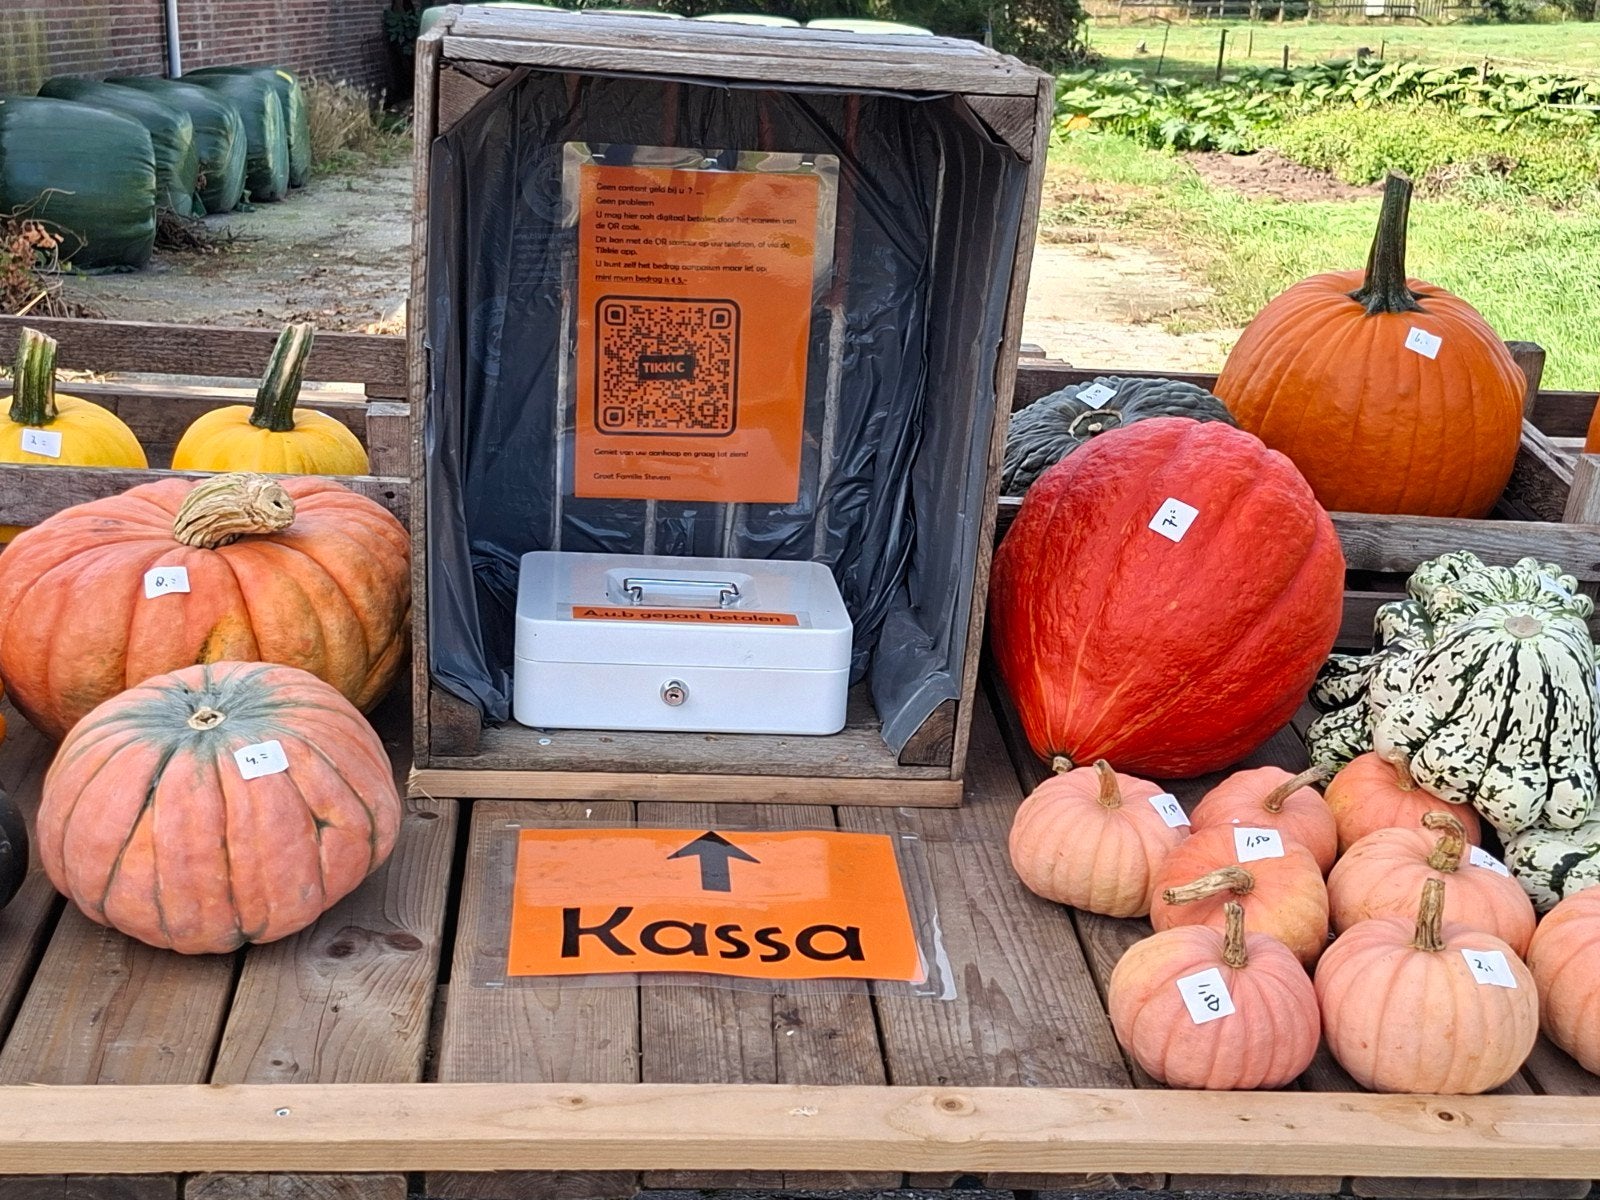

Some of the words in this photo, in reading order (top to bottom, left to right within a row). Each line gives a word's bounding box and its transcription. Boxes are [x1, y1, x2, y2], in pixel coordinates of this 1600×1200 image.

[596, 183, 616, 191] Geen
[667, 186, 677, 195] bij
[596, 197, 616, 205] Geen
[618, 197, 654, 206] probleem
[604, 212, 622, 220] mag
[640, 212, 655, 220] ook
[657, 214, 685, 222] digitaal
[609, 236, 624, 244] kan
[655, 238, 667, 246] QR
[699, 240, 709, 248] op
[621, 248, 638, 256] app.
[624, 261, 636, 269] zelf
[653, 263, 679, 271] bedrag
[635, 274, 662, 284] bedrag
[583, 609, 634, 618] A.u.b
[640, 611, 701, 621] gepast
[708, 612, 781, 622] betalen
[560, 906, 866, 963] Kassa
